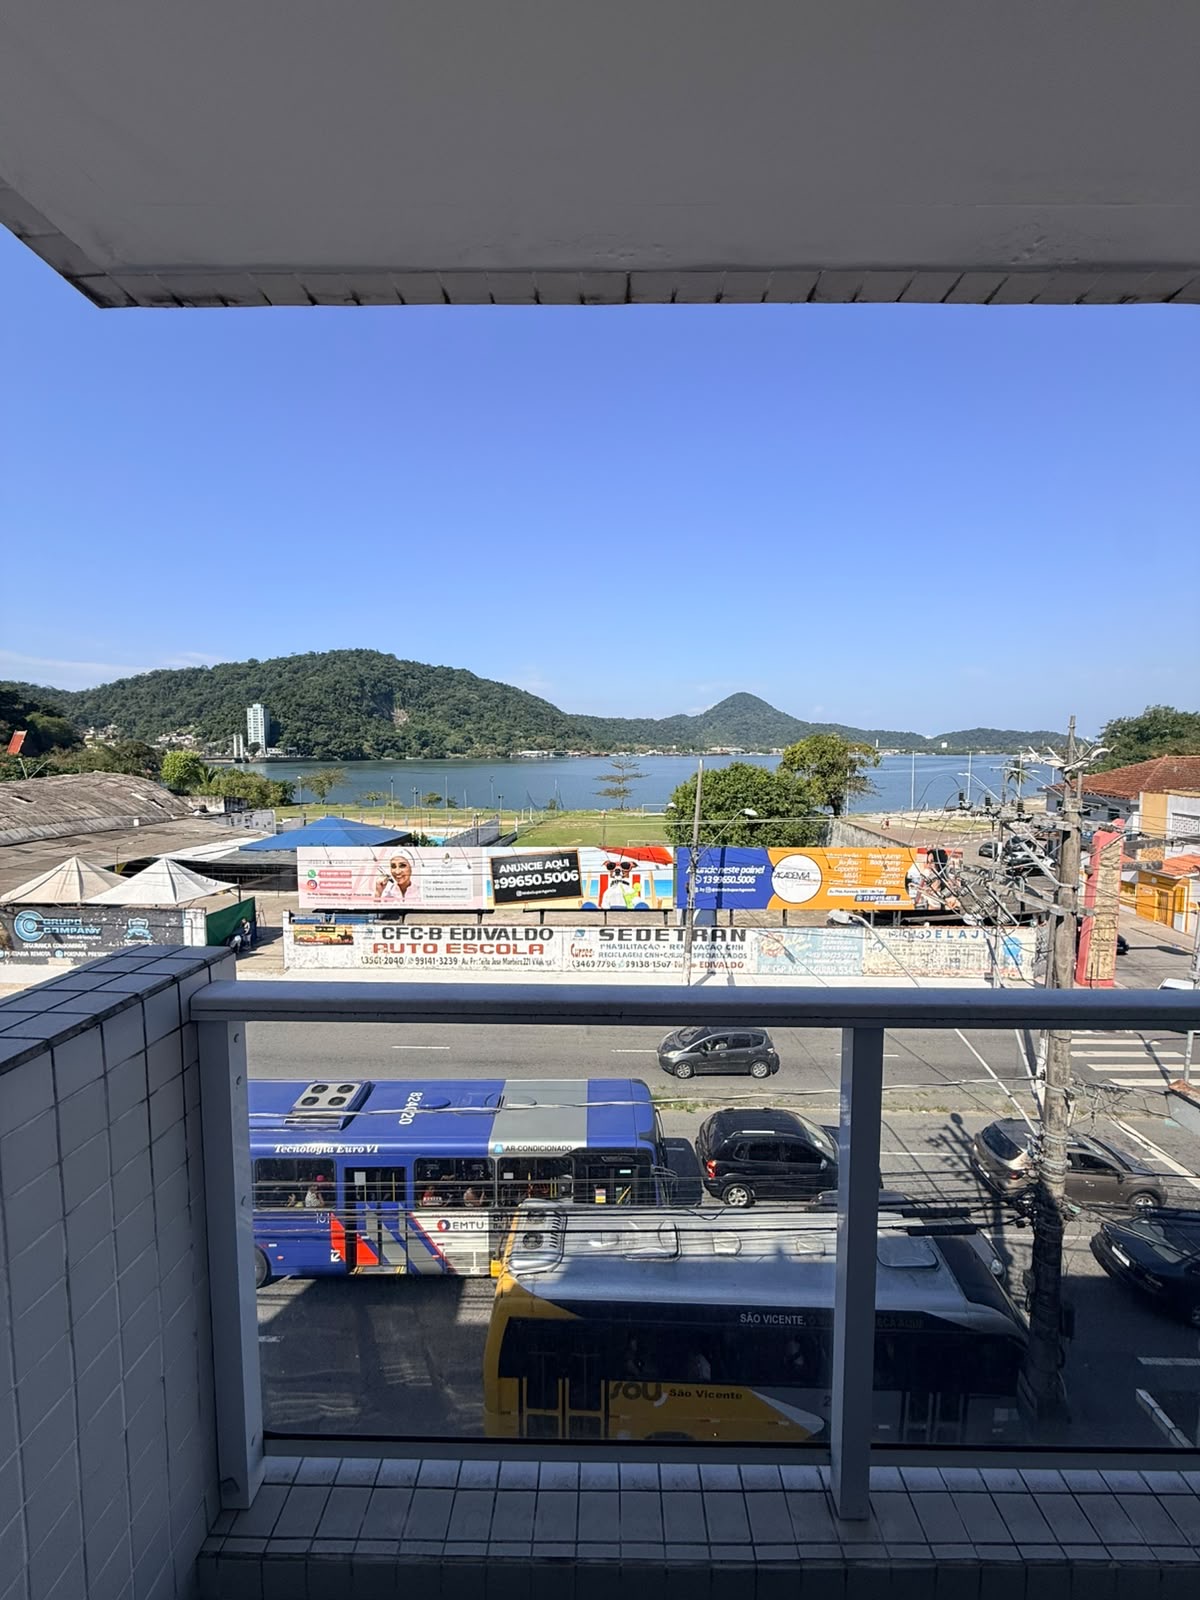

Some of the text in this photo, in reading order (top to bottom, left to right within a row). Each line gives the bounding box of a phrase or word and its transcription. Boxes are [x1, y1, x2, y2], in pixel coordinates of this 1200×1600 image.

[499, 858, 570, 873] ANUNCIE AQUI
[718, 866, 740, 874] neste
[740, 865, 766, 877] painel
[500, 870, 579, 889] 99650.5006
[703, 875, 711, 884] 13
[774, 871, 810, 880] ACADEMIA
[42, 918, 82, 926] GRUPO
[43, 927, 102, 935] COMPANY
[382, 926, 554, 941] CFC-B EDIVALDO
[372, 943, 545, 955] AUTO ESCOLA
[699, 961, 745, 969] EDIVALDO
[274, 1143, 379, 1154] Tecnologia Euro VI
[452, 1221, 485, 1230] EMTU
[739, 1311, 761, 1323] SÃO
[762, 1313, 807, 1326] VICENTE,
[668, 1387, 693, 1399] São
[695, 1388, 743, 1400] Vicente
